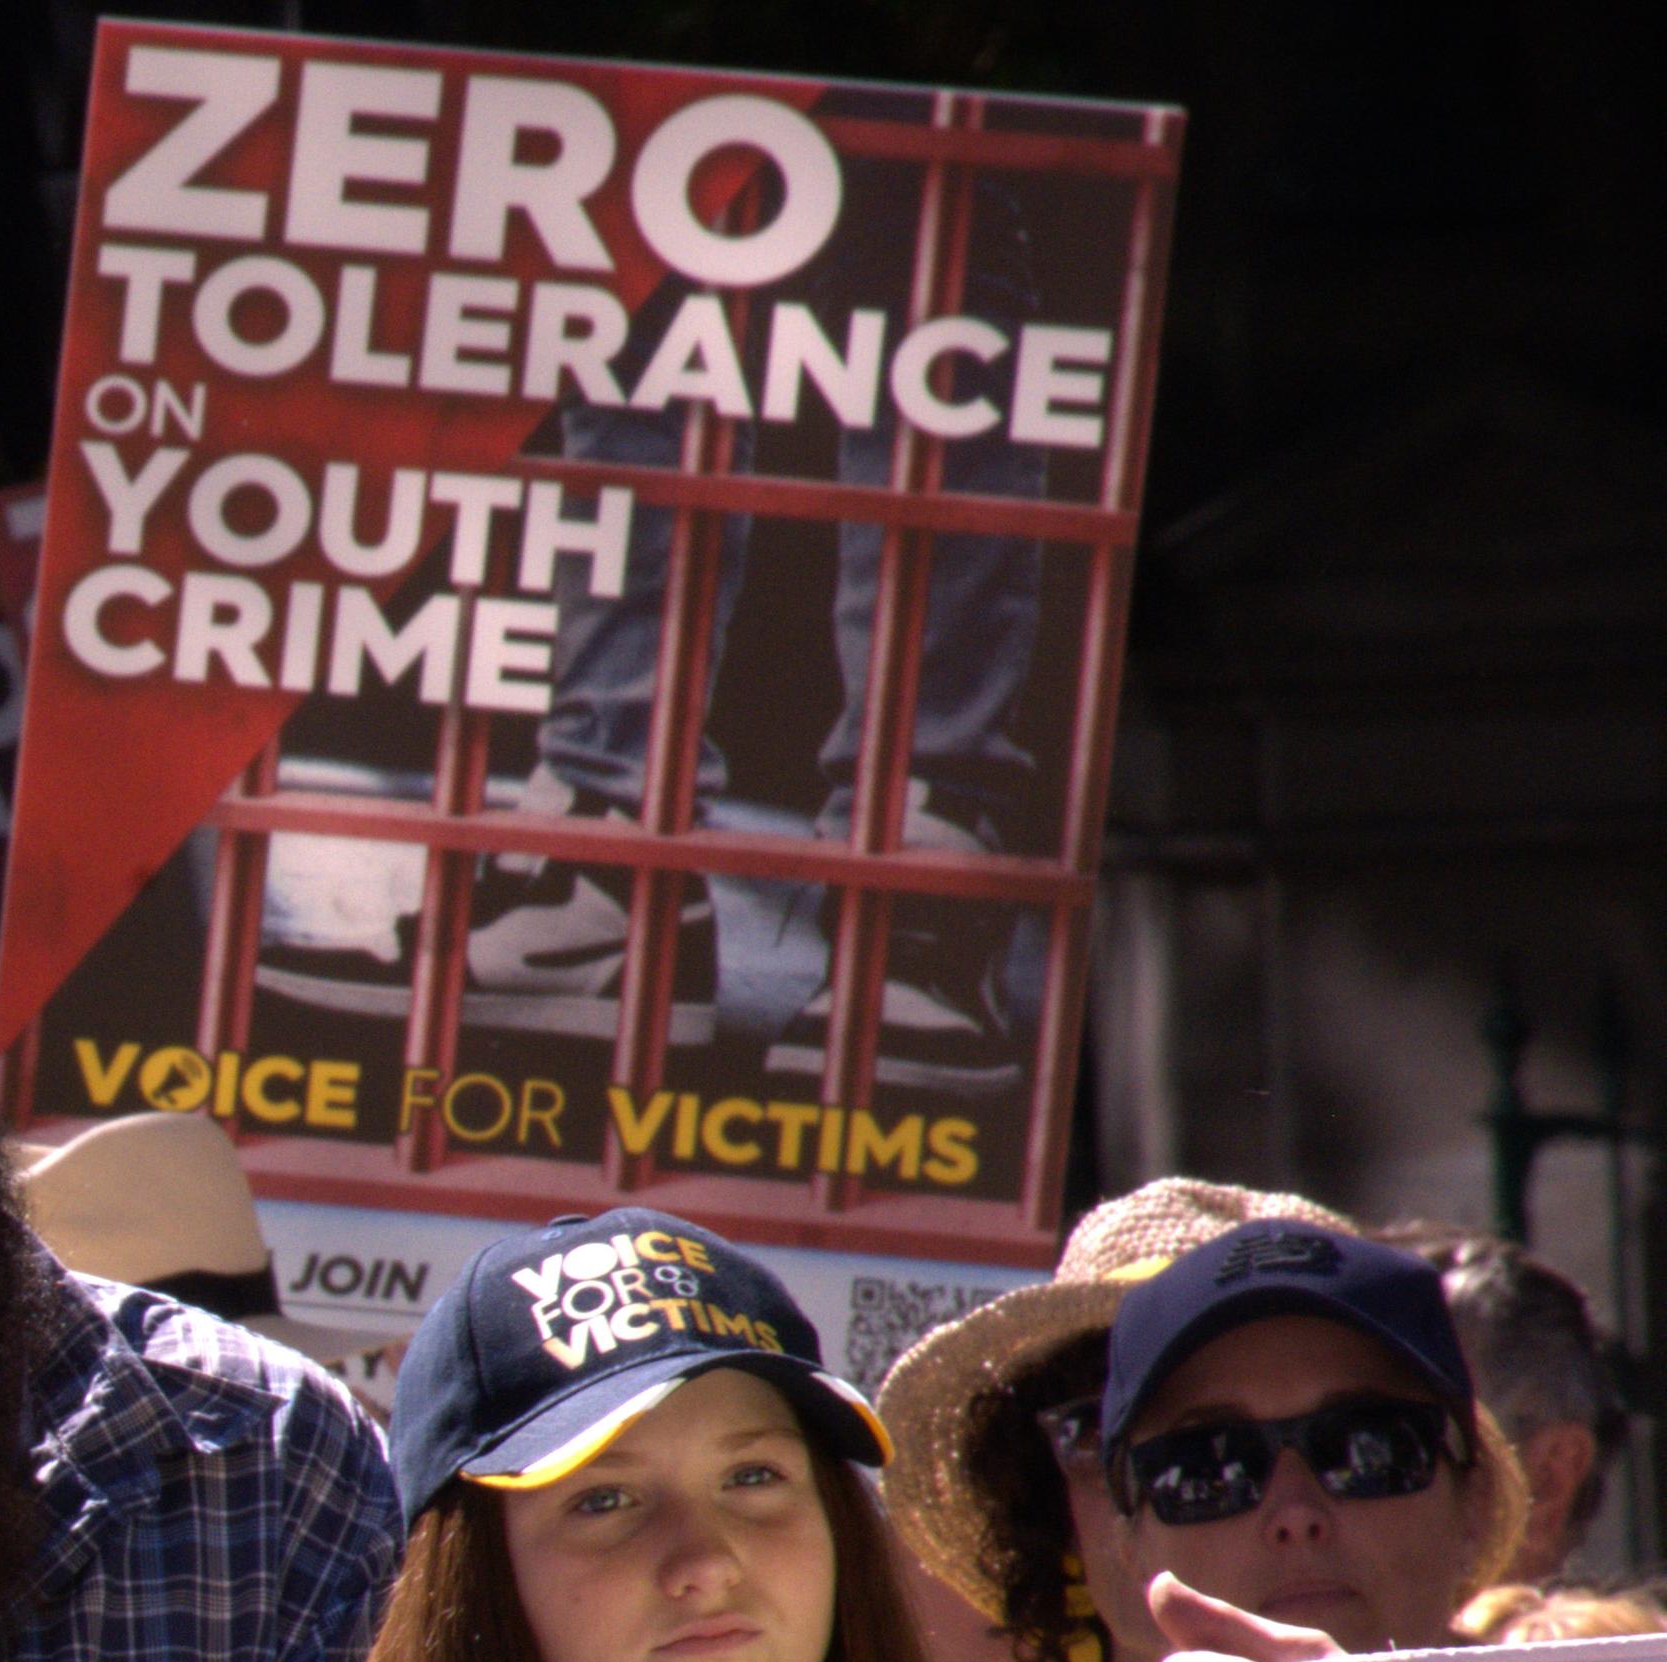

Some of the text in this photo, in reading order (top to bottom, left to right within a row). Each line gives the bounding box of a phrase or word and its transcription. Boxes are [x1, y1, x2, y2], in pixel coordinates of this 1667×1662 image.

[102, 44, 843, 286] ZERO
[97, 243, 1113, 449] TOLERANCE
[84, 374, 206, 442] ON
[79, 441, 635, 598] YOUTH
[62, 563, 561, 715] CRIME
[73, 1037, 980, 1187] VOICE FOR VICTIMS
[289, 1252, 430, 1304] JOIN
[511, 1229, 715, 1301] VOICE
[529, 1266, 654, 1340] FOR
[542, 1298, 785, 1371] VICTIMS
